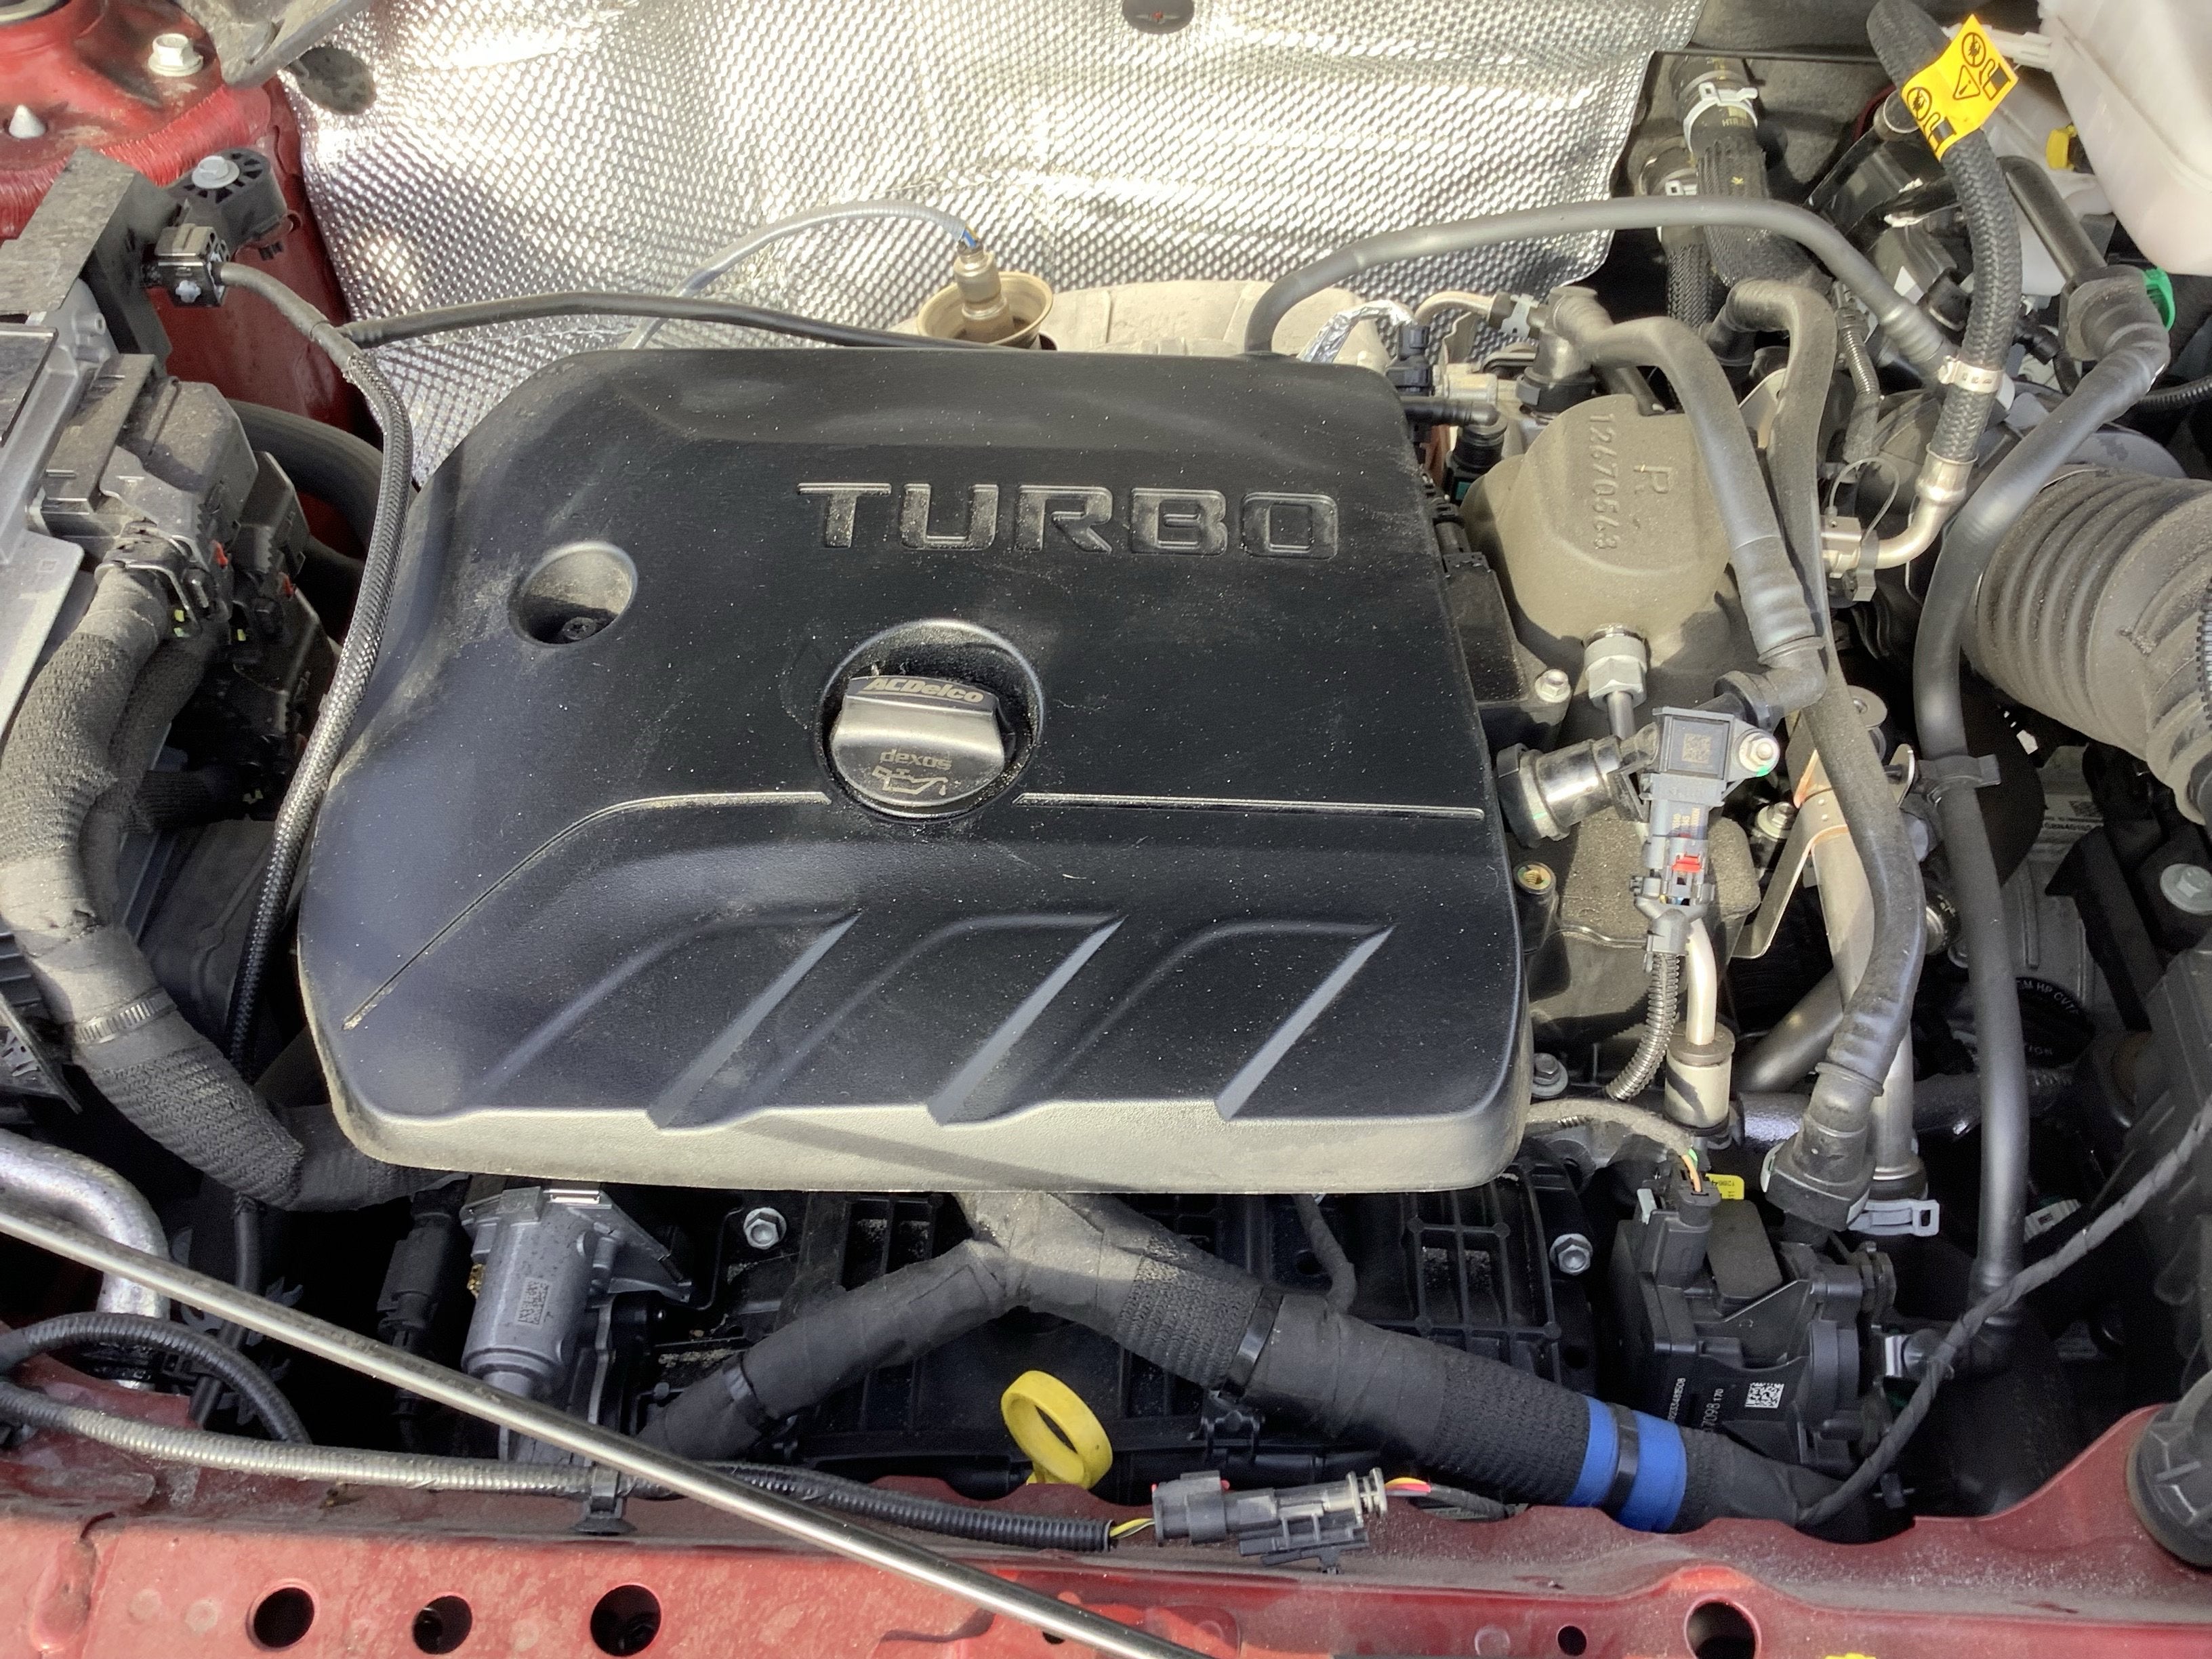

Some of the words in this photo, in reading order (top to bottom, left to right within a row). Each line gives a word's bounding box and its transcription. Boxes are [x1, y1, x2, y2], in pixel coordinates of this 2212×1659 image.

[796, 481, 1339, 560] TURBO
[862, 678, 984, 703] ACDelco
[880, 748, 953, 771] dexos
